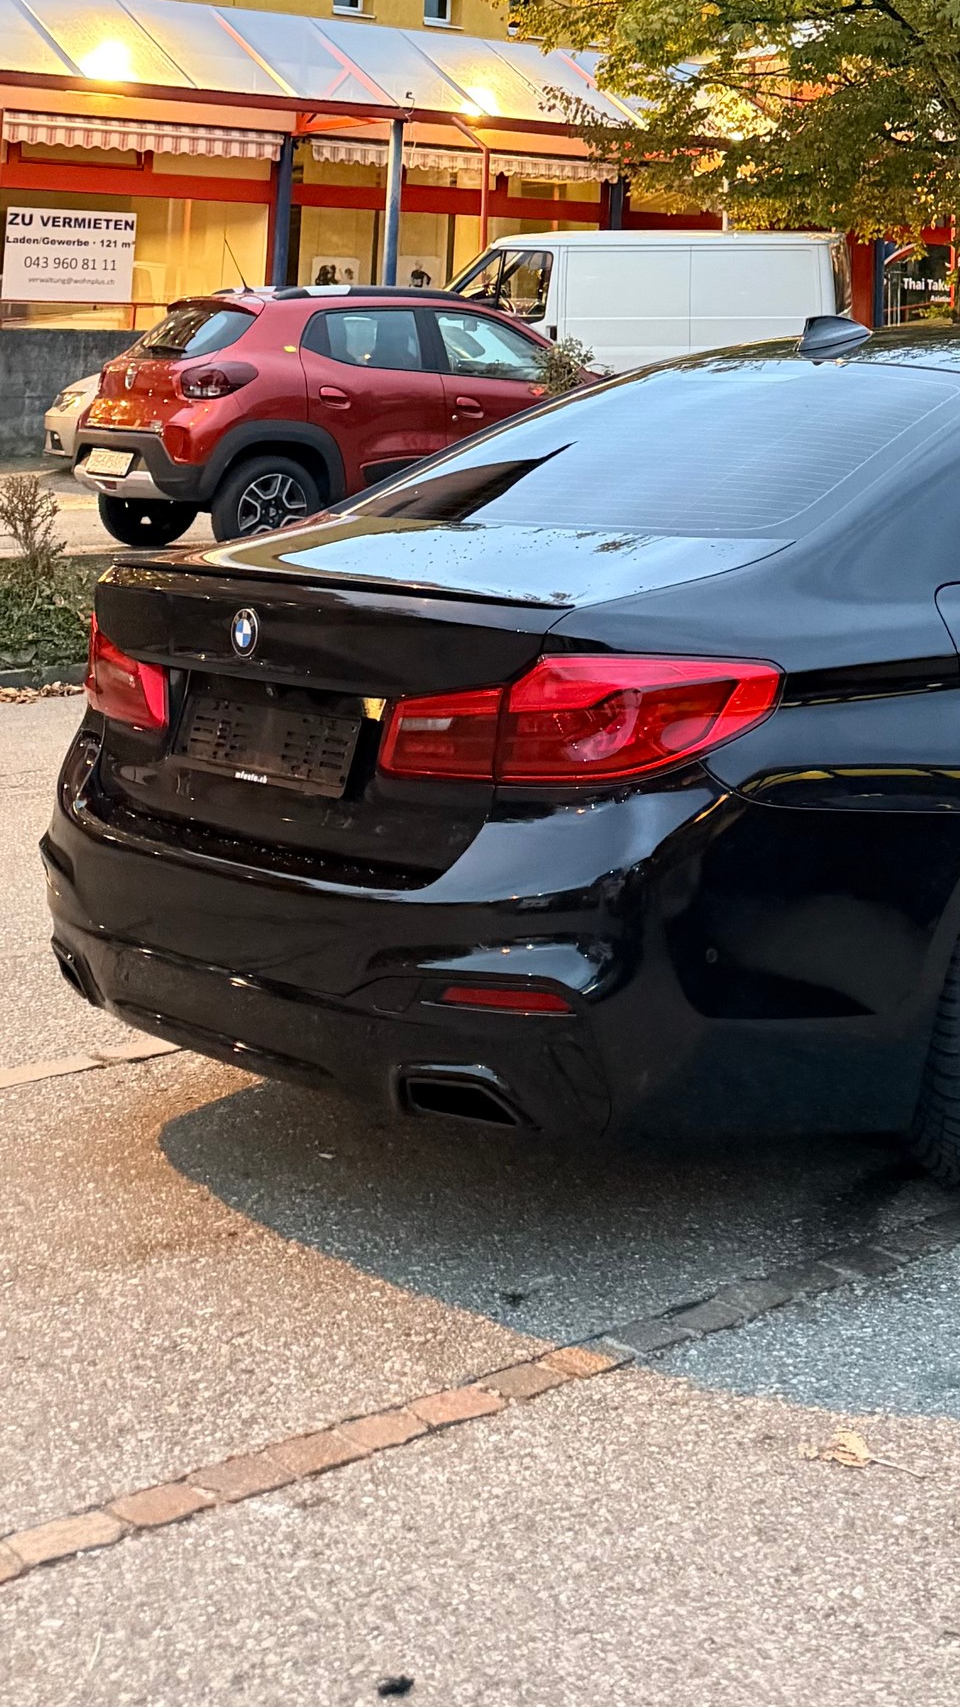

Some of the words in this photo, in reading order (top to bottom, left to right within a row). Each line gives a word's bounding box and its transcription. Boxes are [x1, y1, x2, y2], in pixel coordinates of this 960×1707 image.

[8, 213, 34, 226] ZU
[40, 215, 135, 231] VERMIETEN
[6, 236, 89, 246] Laden/Gewerbe
[100, 239, 117, 248] 121
[24, 256, 49, 268] 043
[53, 257, 78, 270] 960
[81, 258, 97, 270] 81
[102, 259, 117, 271] 11
[903, 277, 925, 290] Thai
